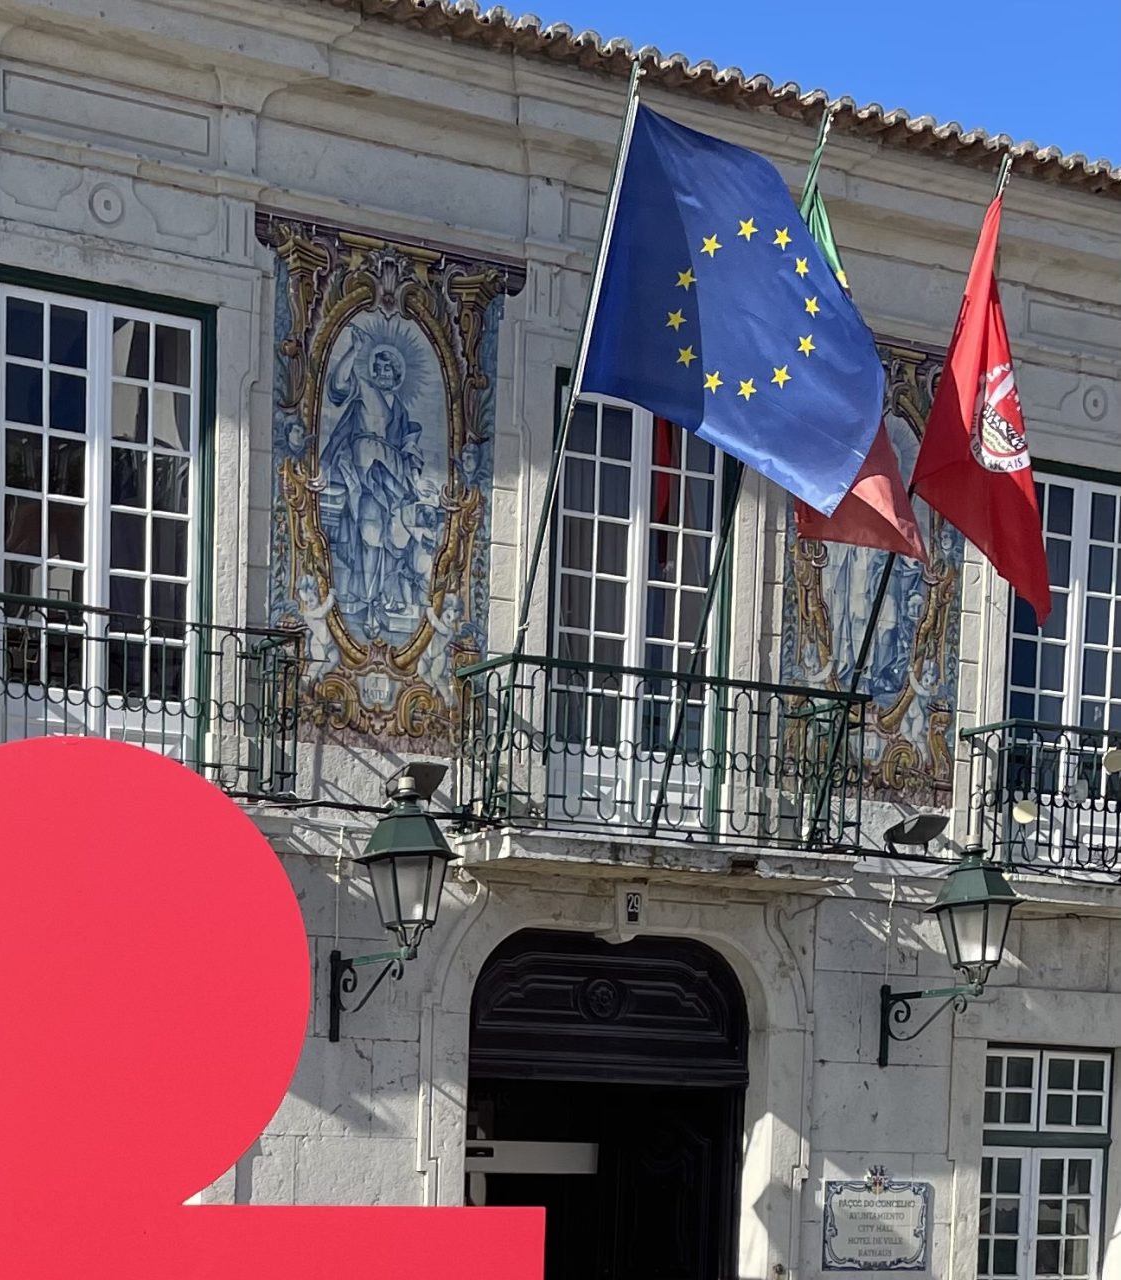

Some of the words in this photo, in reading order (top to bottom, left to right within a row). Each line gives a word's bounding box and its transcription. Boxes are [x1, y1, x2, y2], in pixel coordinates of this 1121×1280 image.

[627, 894, 641, 913] 29
[864, 1199, 874, 1208] DO
[875, 1199, 916, 1208] CONCELHO
[857, 1224, 875, 1233] CITY
[876, 1224, 894, 1233] HALL
[847, 1237, 871, 1245] HOTEL
[872, 1237, 882, 1245] DE
[882, 1237, 904, 1245] VILLE
[857, 1248, 892, 1257] RATHAUS
